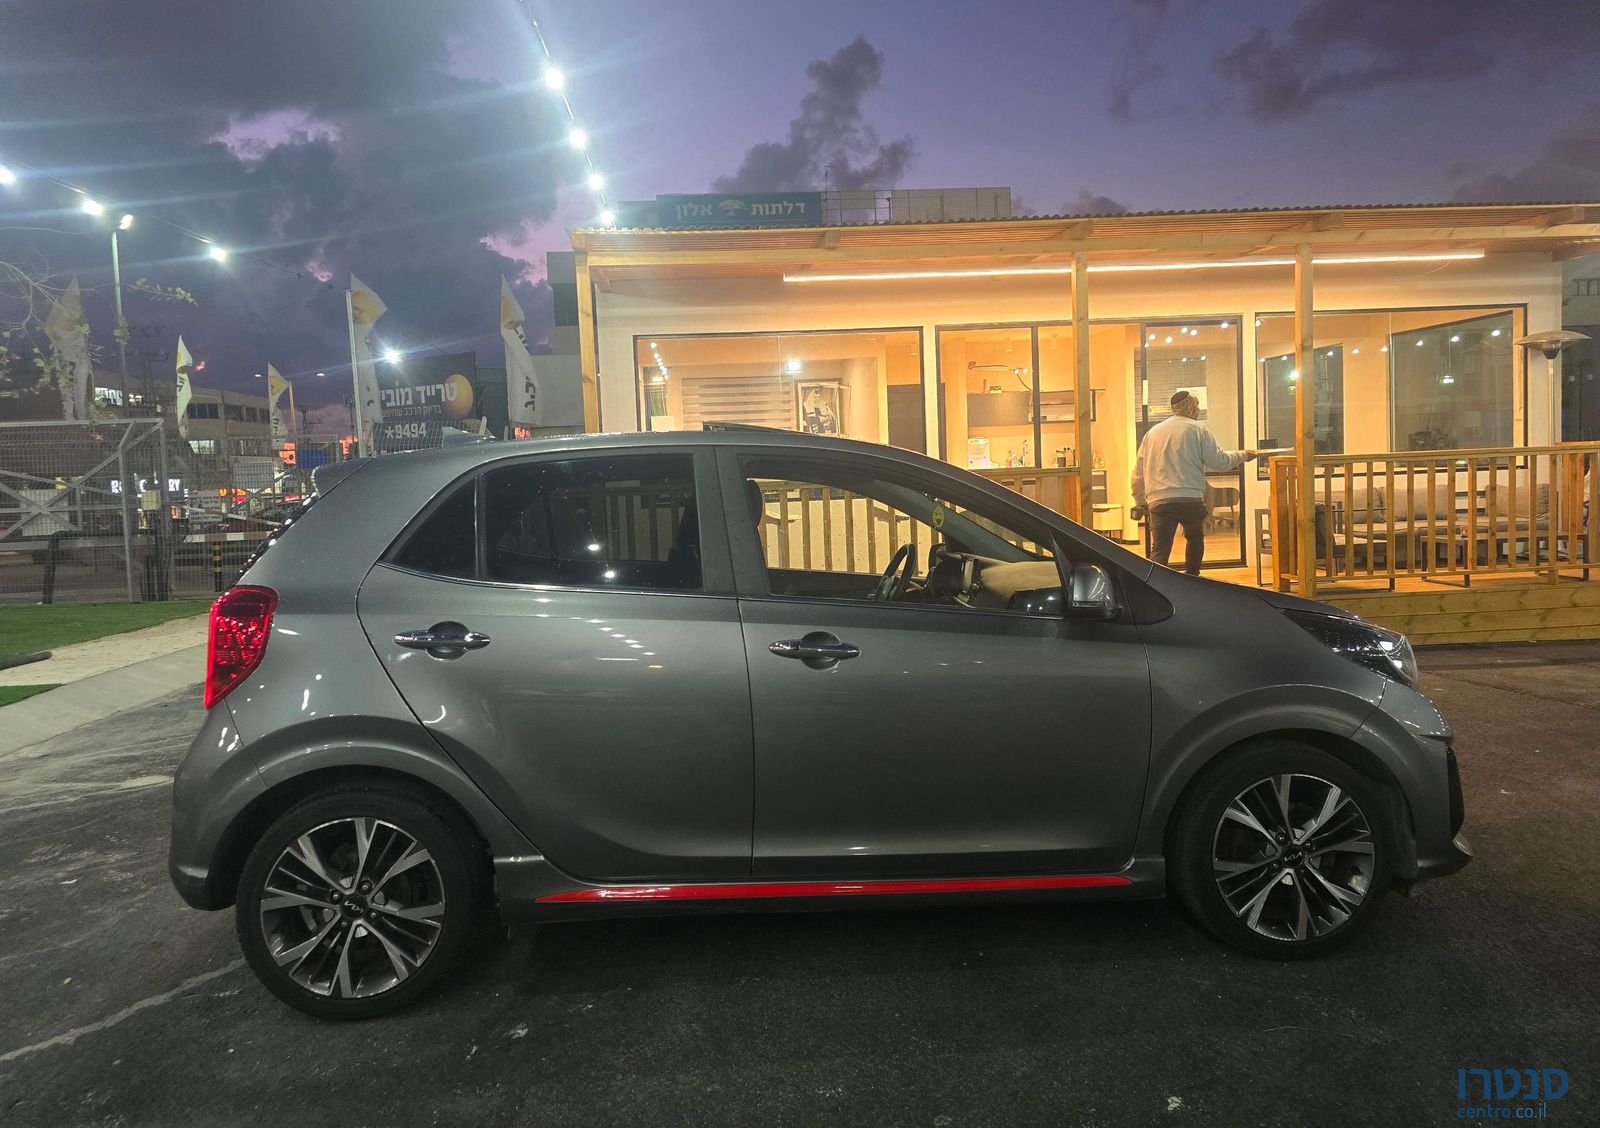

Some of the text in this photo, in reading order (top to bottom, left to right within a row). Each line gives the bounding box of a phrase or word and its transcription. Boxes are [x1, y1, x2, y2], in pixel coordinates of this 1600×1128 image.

[675, 200, 806, 220] דלתות אלון
[380, 382, 457, 407] טרייד מובי
